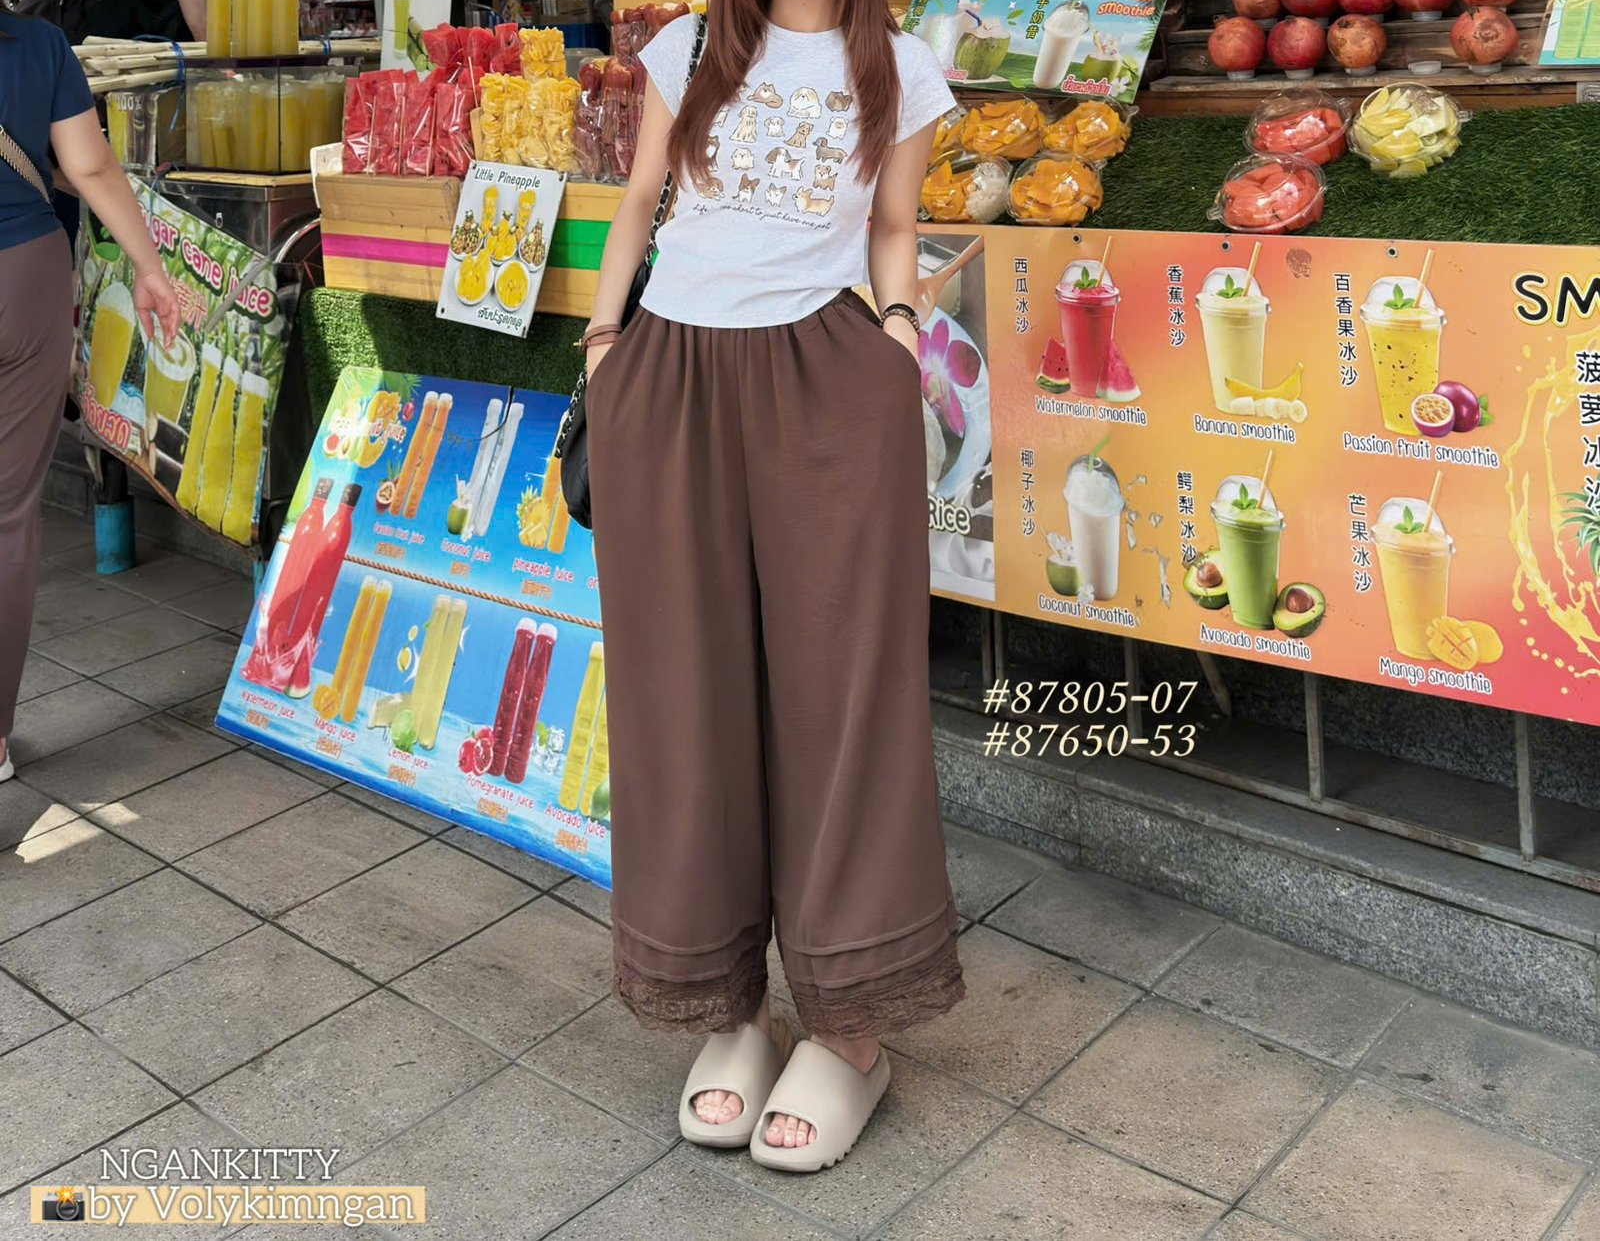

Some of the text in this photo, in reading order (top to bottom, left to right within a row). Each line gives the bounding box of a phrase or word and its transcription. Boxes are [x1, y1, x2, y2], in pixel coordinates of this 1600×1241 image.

[474, 168, 541, 189] Little Pineapple
[150, 215, 178, 251] gar
[181, 237, 223, 290] cane
[1014, 258, 1030, 333] 西瓜冰沙
[1167, 265, 1185, 346] 香蕉冰沙
[1334, 273, 1358, 386] 百香果冰沙
[1036, 396, 1147, 424] Watermelon smoothie
[1194, 415, 1296, 443] Banana smoothie
[1343, 433, 1499, 467] Passion fruit smoothie
[1021, 449, 1035, 535] 椰子冰沙
[1349, 494, 1372, 592] 芒果冰沙
[1039, 595, 1135, 626] Coconut smoothie
[1200, 625, 1311, 660] Avocado smoothie
[1379, 658, 1492, 694] Mango smoothie
[466, 774, 515, 801] Pomegranate
[516, 795, 535, 809] juice
[544, 803, 607, 839] Avocado juice
